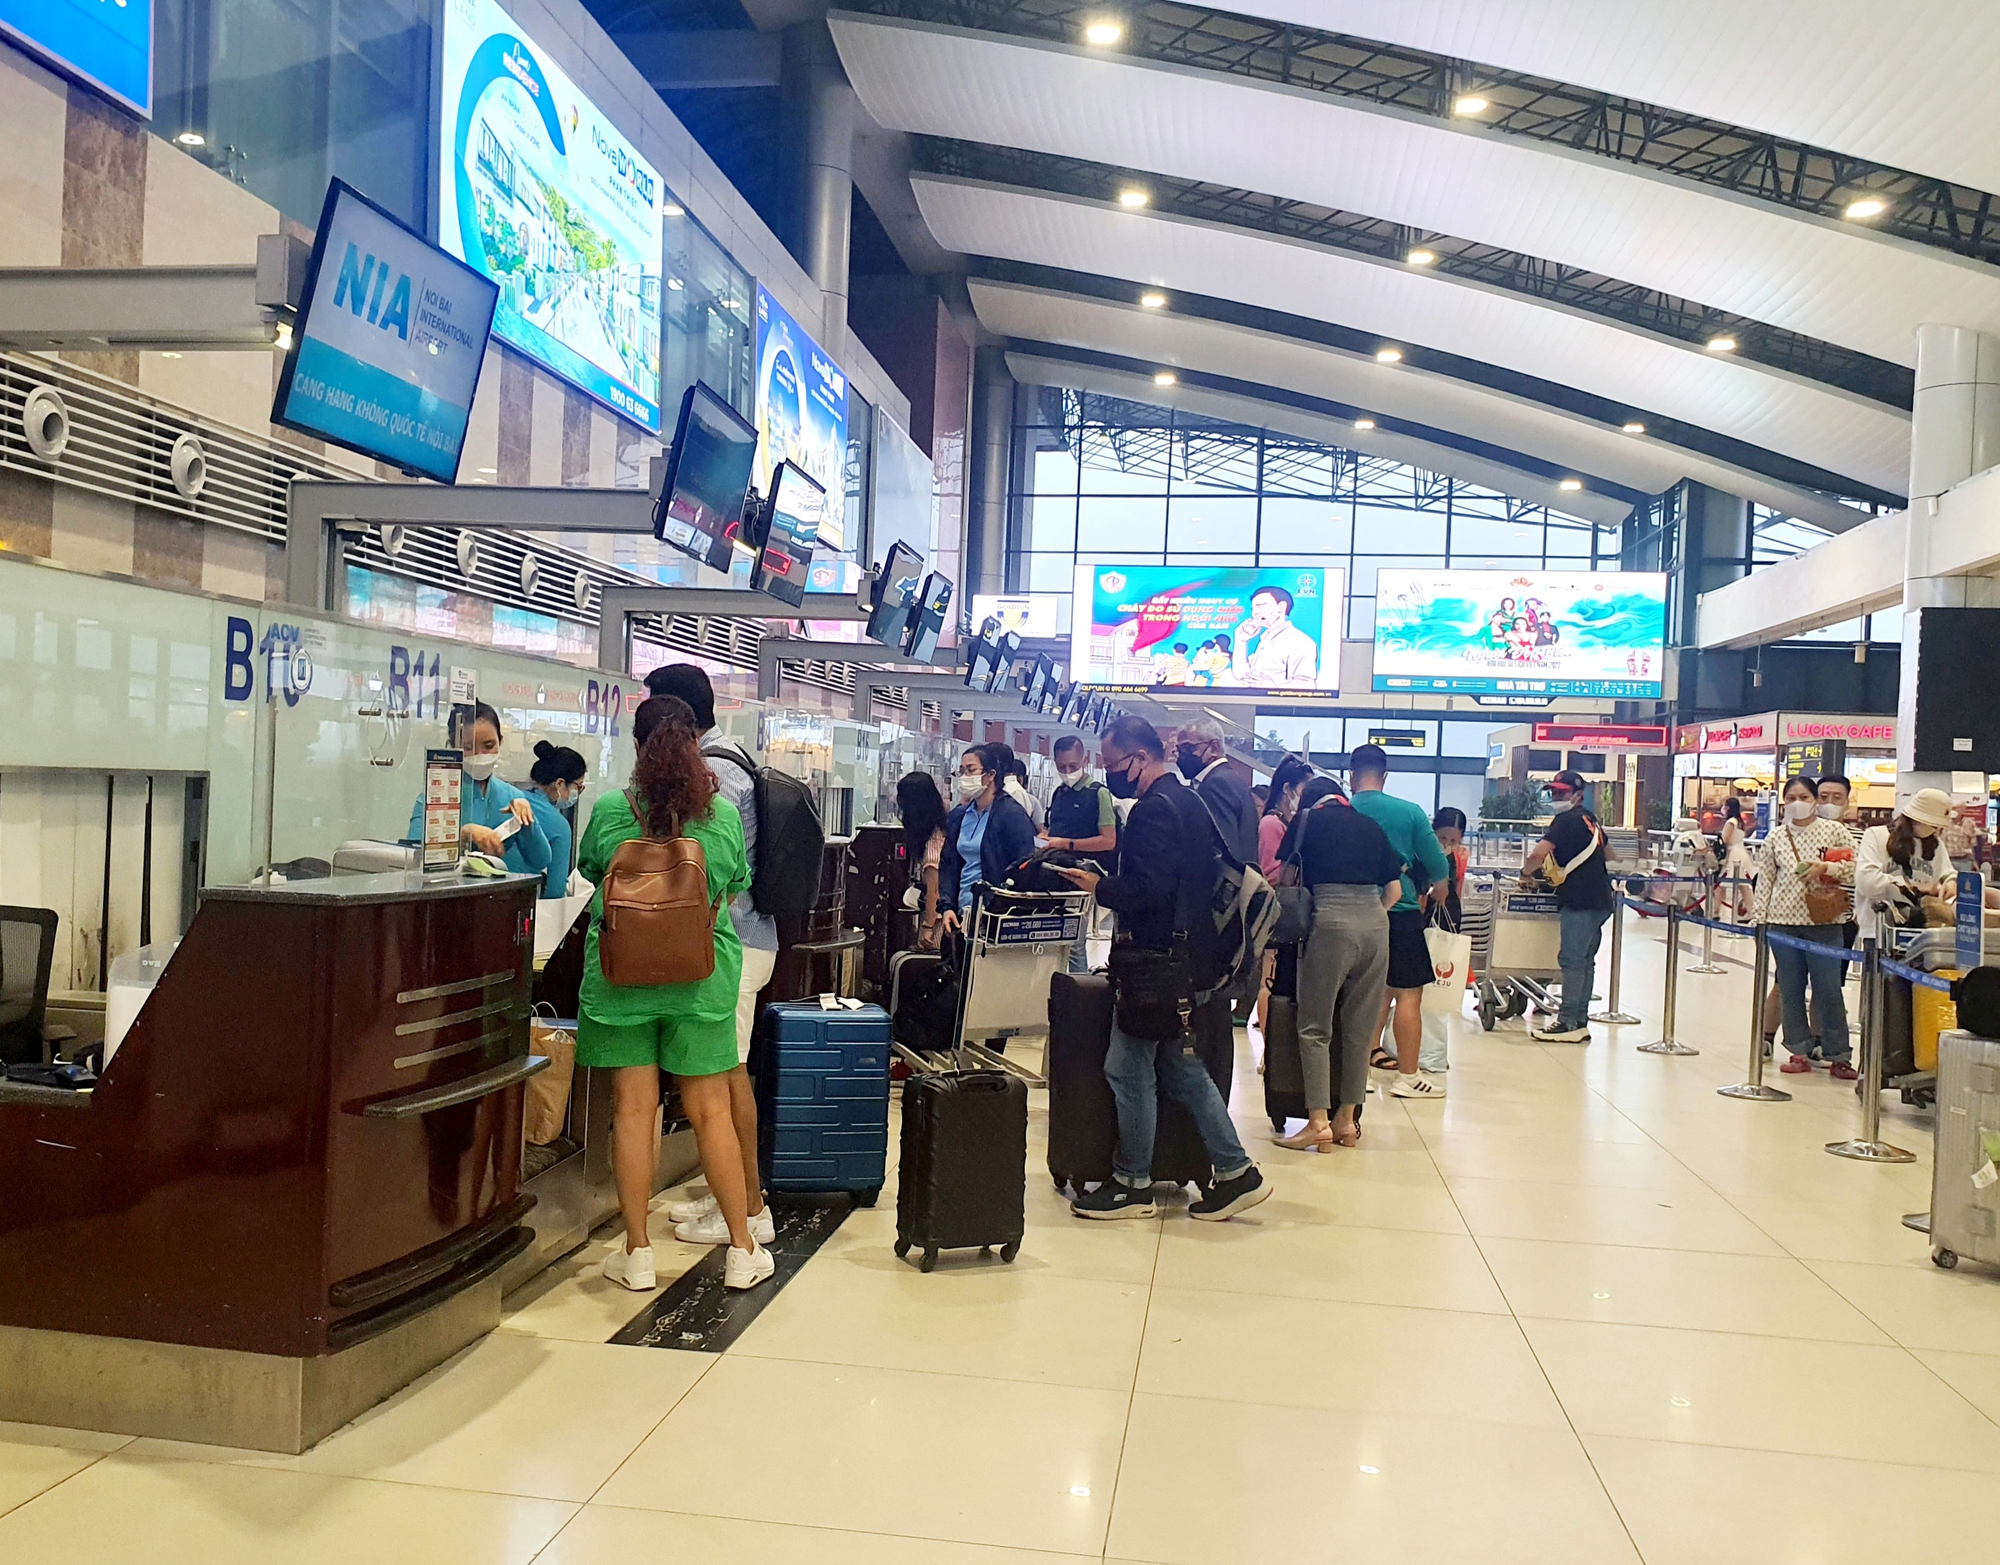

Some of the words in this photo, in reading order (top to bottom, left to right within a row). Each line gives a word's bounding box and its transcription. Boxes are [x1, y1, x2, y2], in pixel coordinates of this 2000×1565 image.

[333, 242, 411, 341] NIA
[419, 308, 473, 350] INTERNATIONAL
[355, 396, 389, 428] KHÔNG
[1143, 614, 1180, 622] TRONG
[1147, 605, 1164, 613] DO
[1549, 661, 1561, 669] 2022
[390, 645, 441, 721] B11
[586, 679, 621, 737] B12
[1788, 723, 1846, 738] LUCKY
[1847, 724, 1894, 739] CAFE
